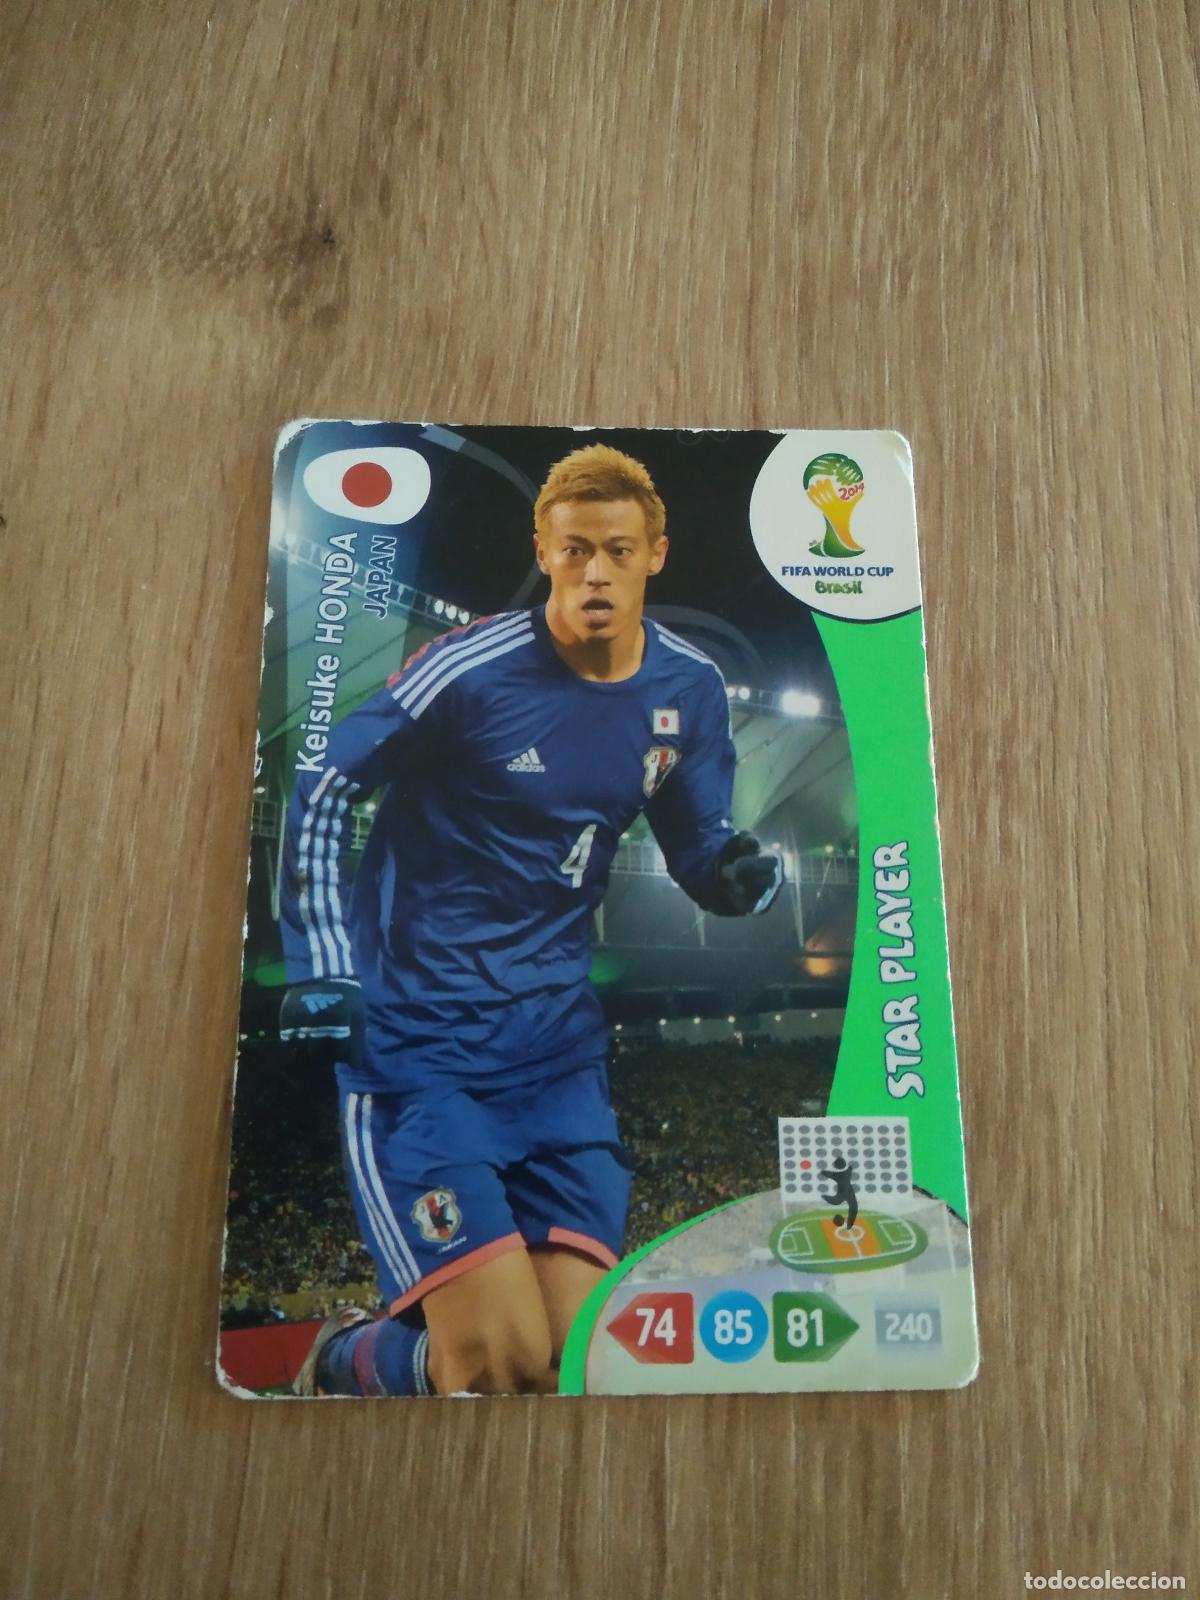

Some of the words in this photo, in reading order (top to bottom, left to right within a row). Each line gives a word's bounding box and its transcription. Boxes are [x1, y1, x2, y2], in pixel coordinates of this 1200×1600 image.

[838, 482, 865, 501] 2014
[314, 532, 359, 645] HONDA
[362, 535, 398, 620] JAPAN
[781, 566, 812, 577] FIFA
[813, 566, 864, 577] WORLD
[867, 566, 894, 577] CUP
[815, 580, 863, 594] Brasil
[294, 653, 341, 774] Keisuke
[560, 823, 598, 888] 4
[873, 841, 917, 983] PLAYER
[882, 994, 925, 1099] STAR
[635, 1308, 677, 1347] 74
[713, 1308, 753, 1346] 85
[786, 1308, 825, 1347] 81
[884, 1312, 933, 1341] 240
